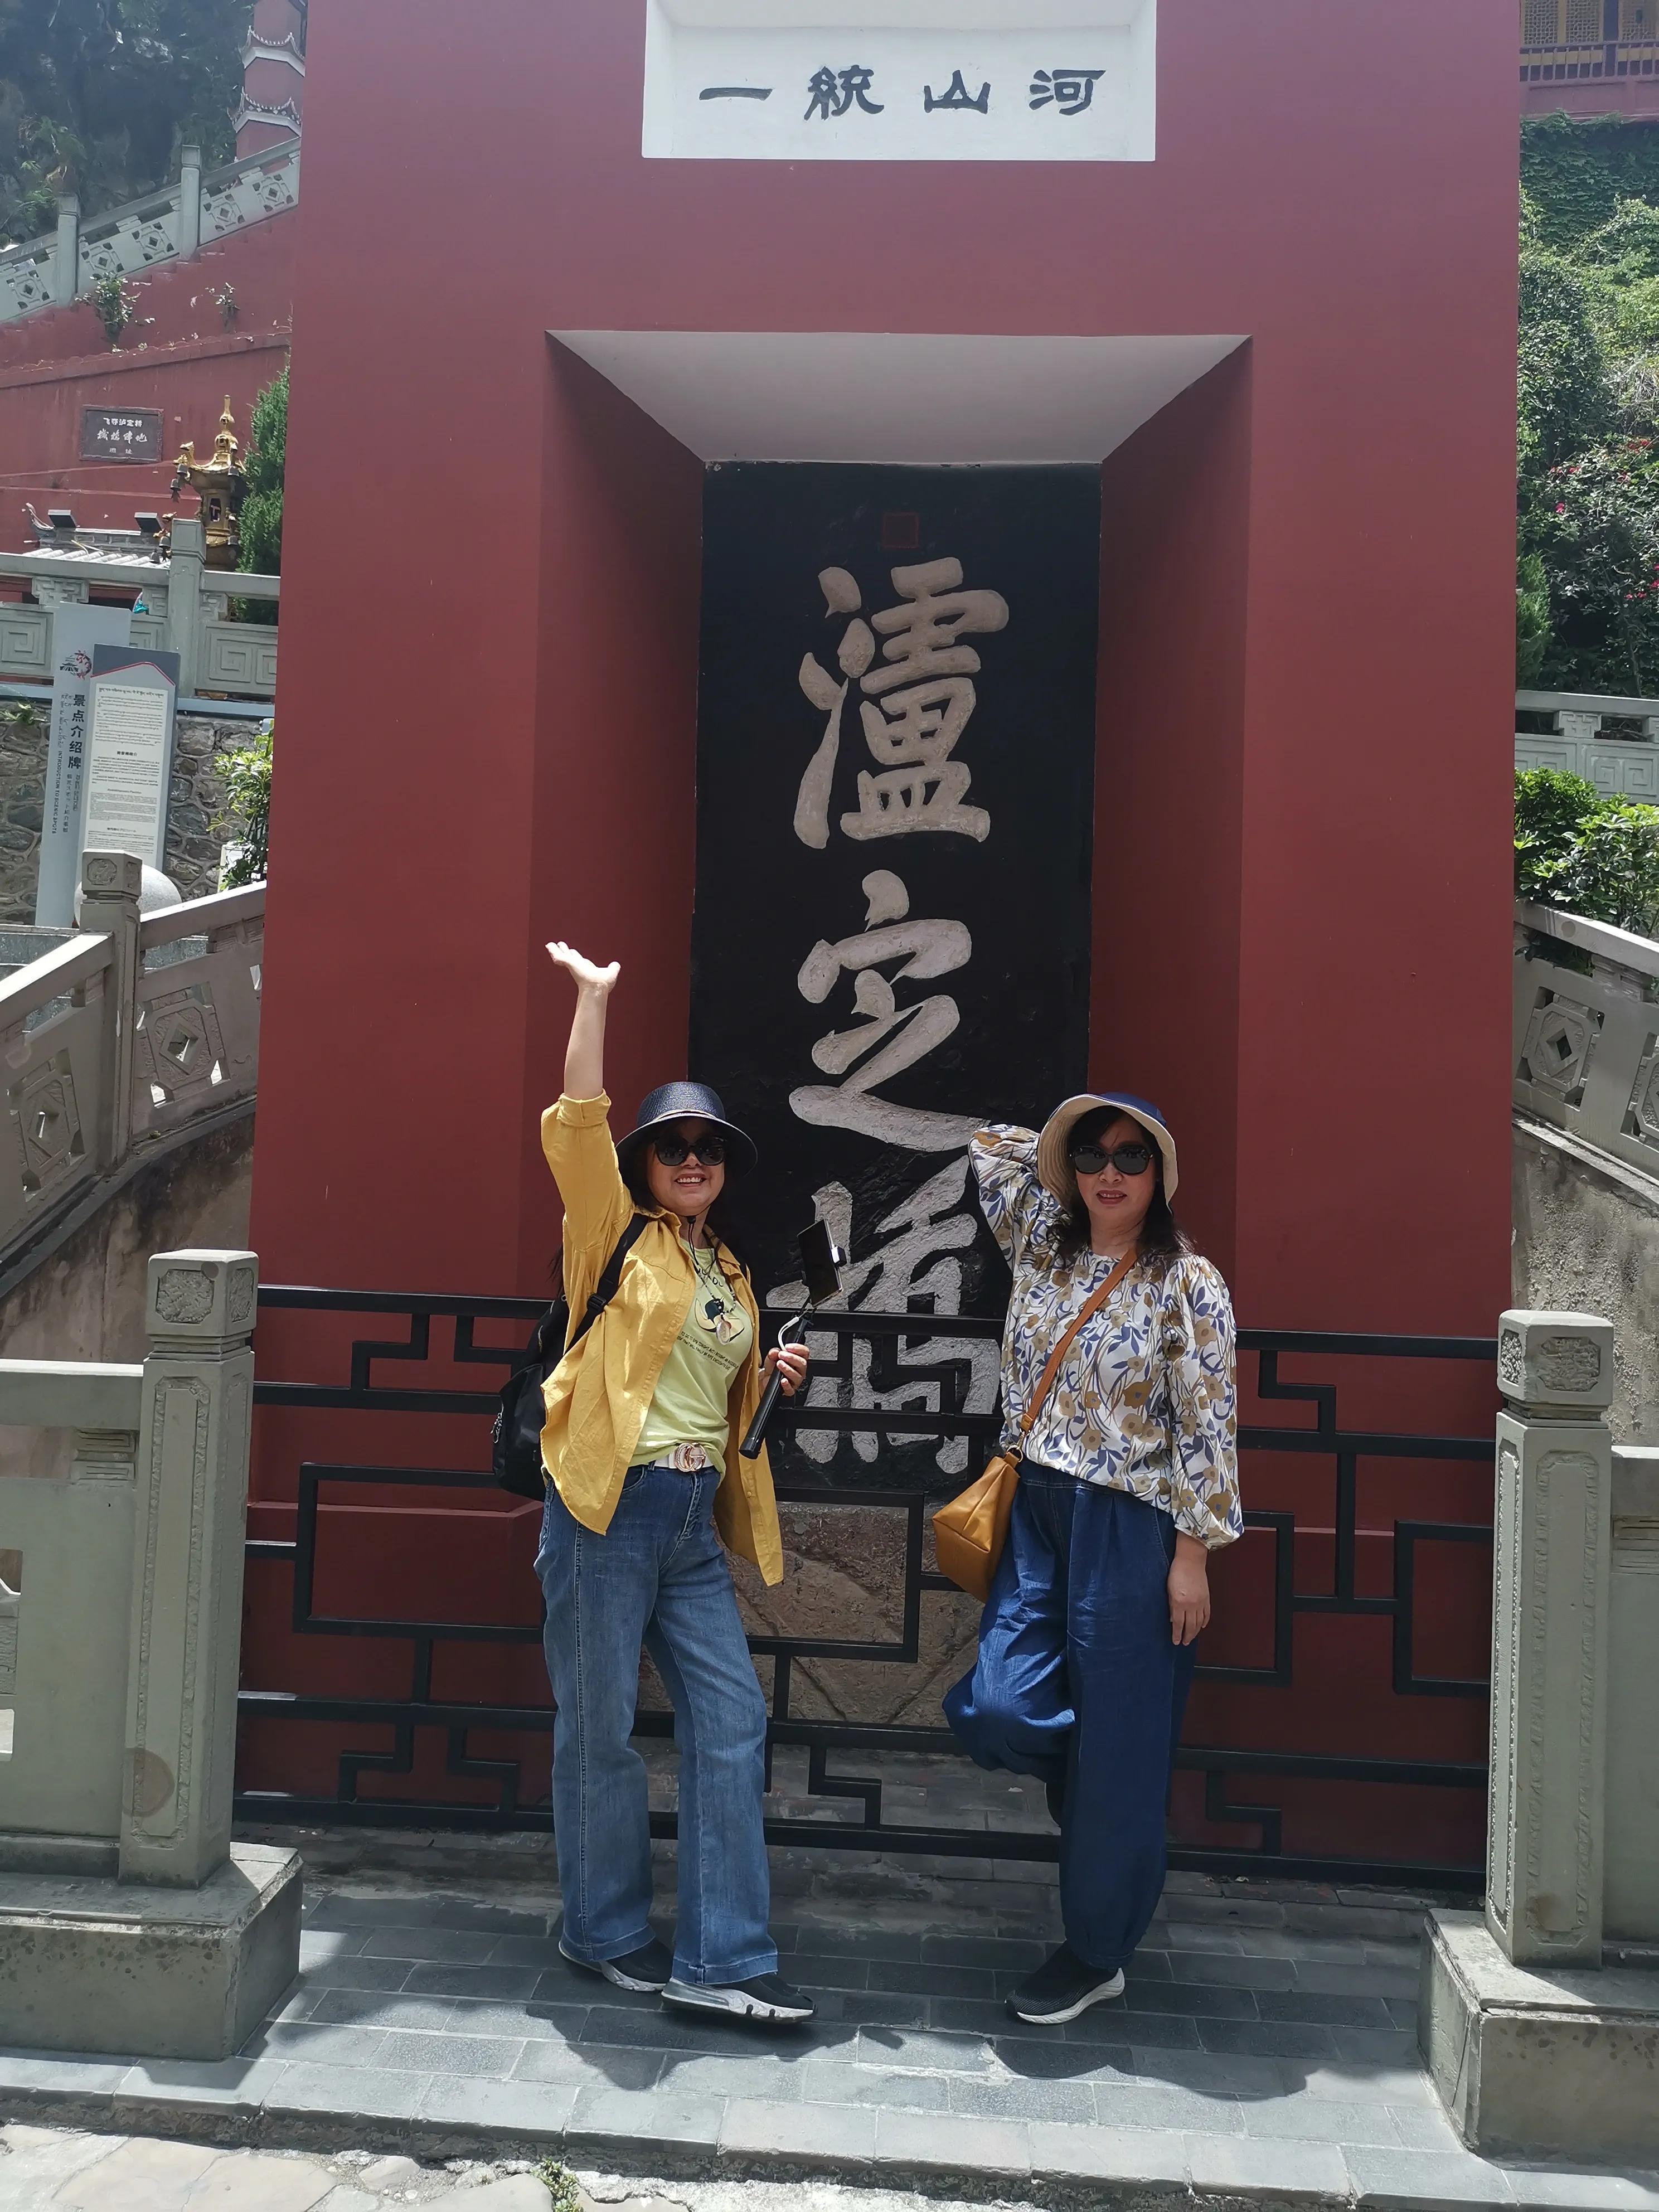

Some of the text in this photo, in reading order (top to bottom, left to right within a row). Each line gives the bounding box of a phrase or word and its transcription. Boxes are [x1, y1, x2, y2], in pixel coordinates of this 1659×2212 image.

[67, 694, 86, 769] 景点介绍牌
